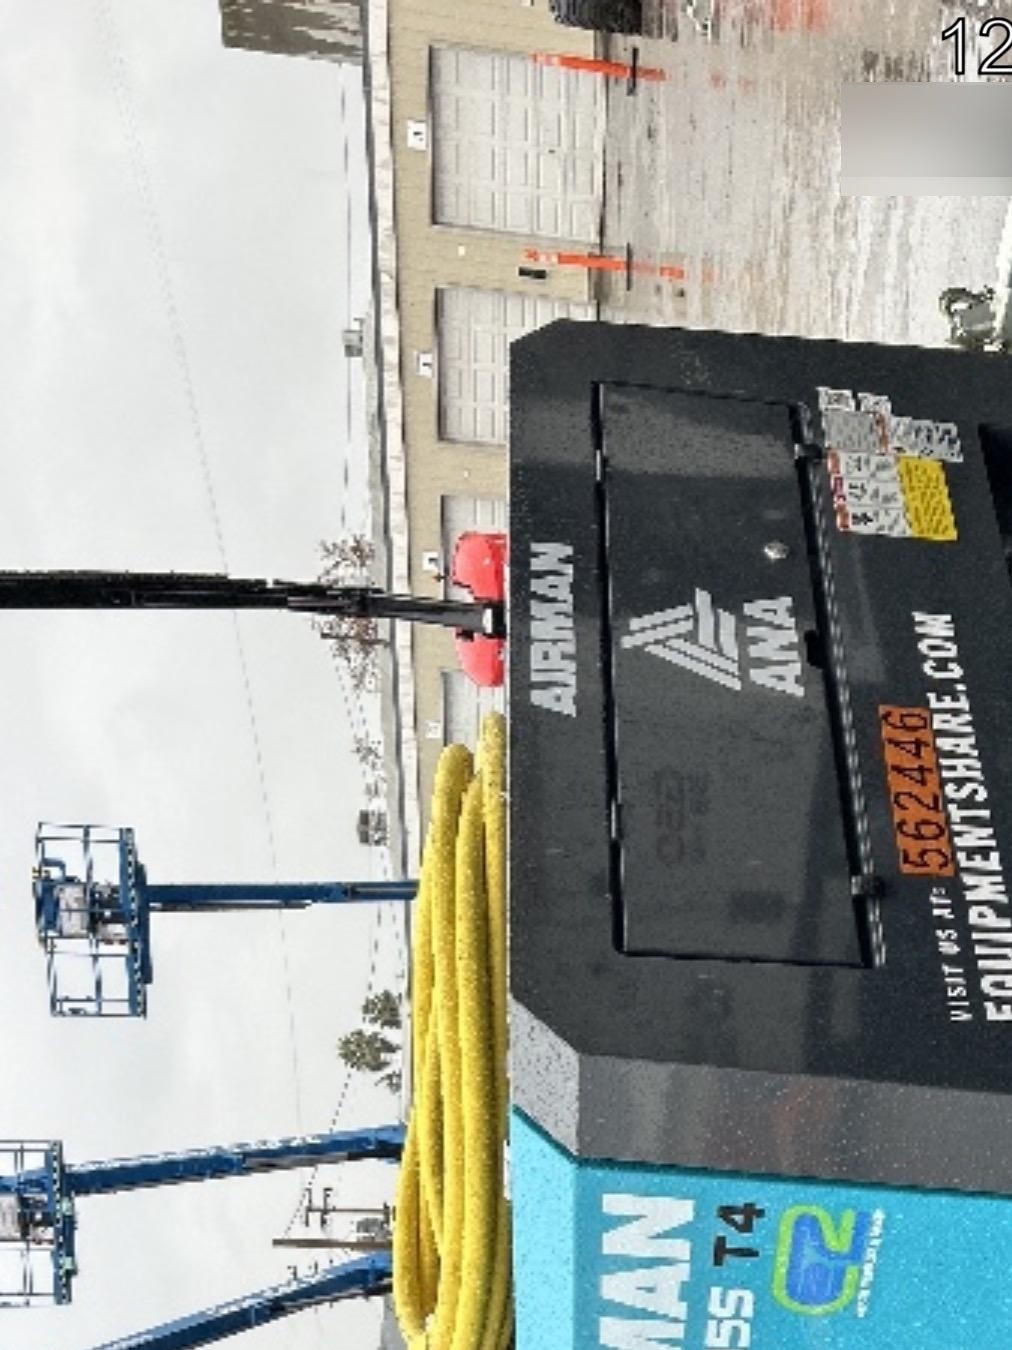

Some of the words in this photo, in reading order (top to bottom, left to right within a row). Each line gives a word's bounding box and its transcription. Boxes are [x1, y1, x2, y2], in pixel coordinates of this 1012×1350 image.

[529, 543, 577, 718] AIRMAN
[744, 597, 804, 697] ANA
[881, 710, 950, 871] 562446
[941, 965, 973, 1021] VISIT
[713, 1202, 765, 1267] T4
